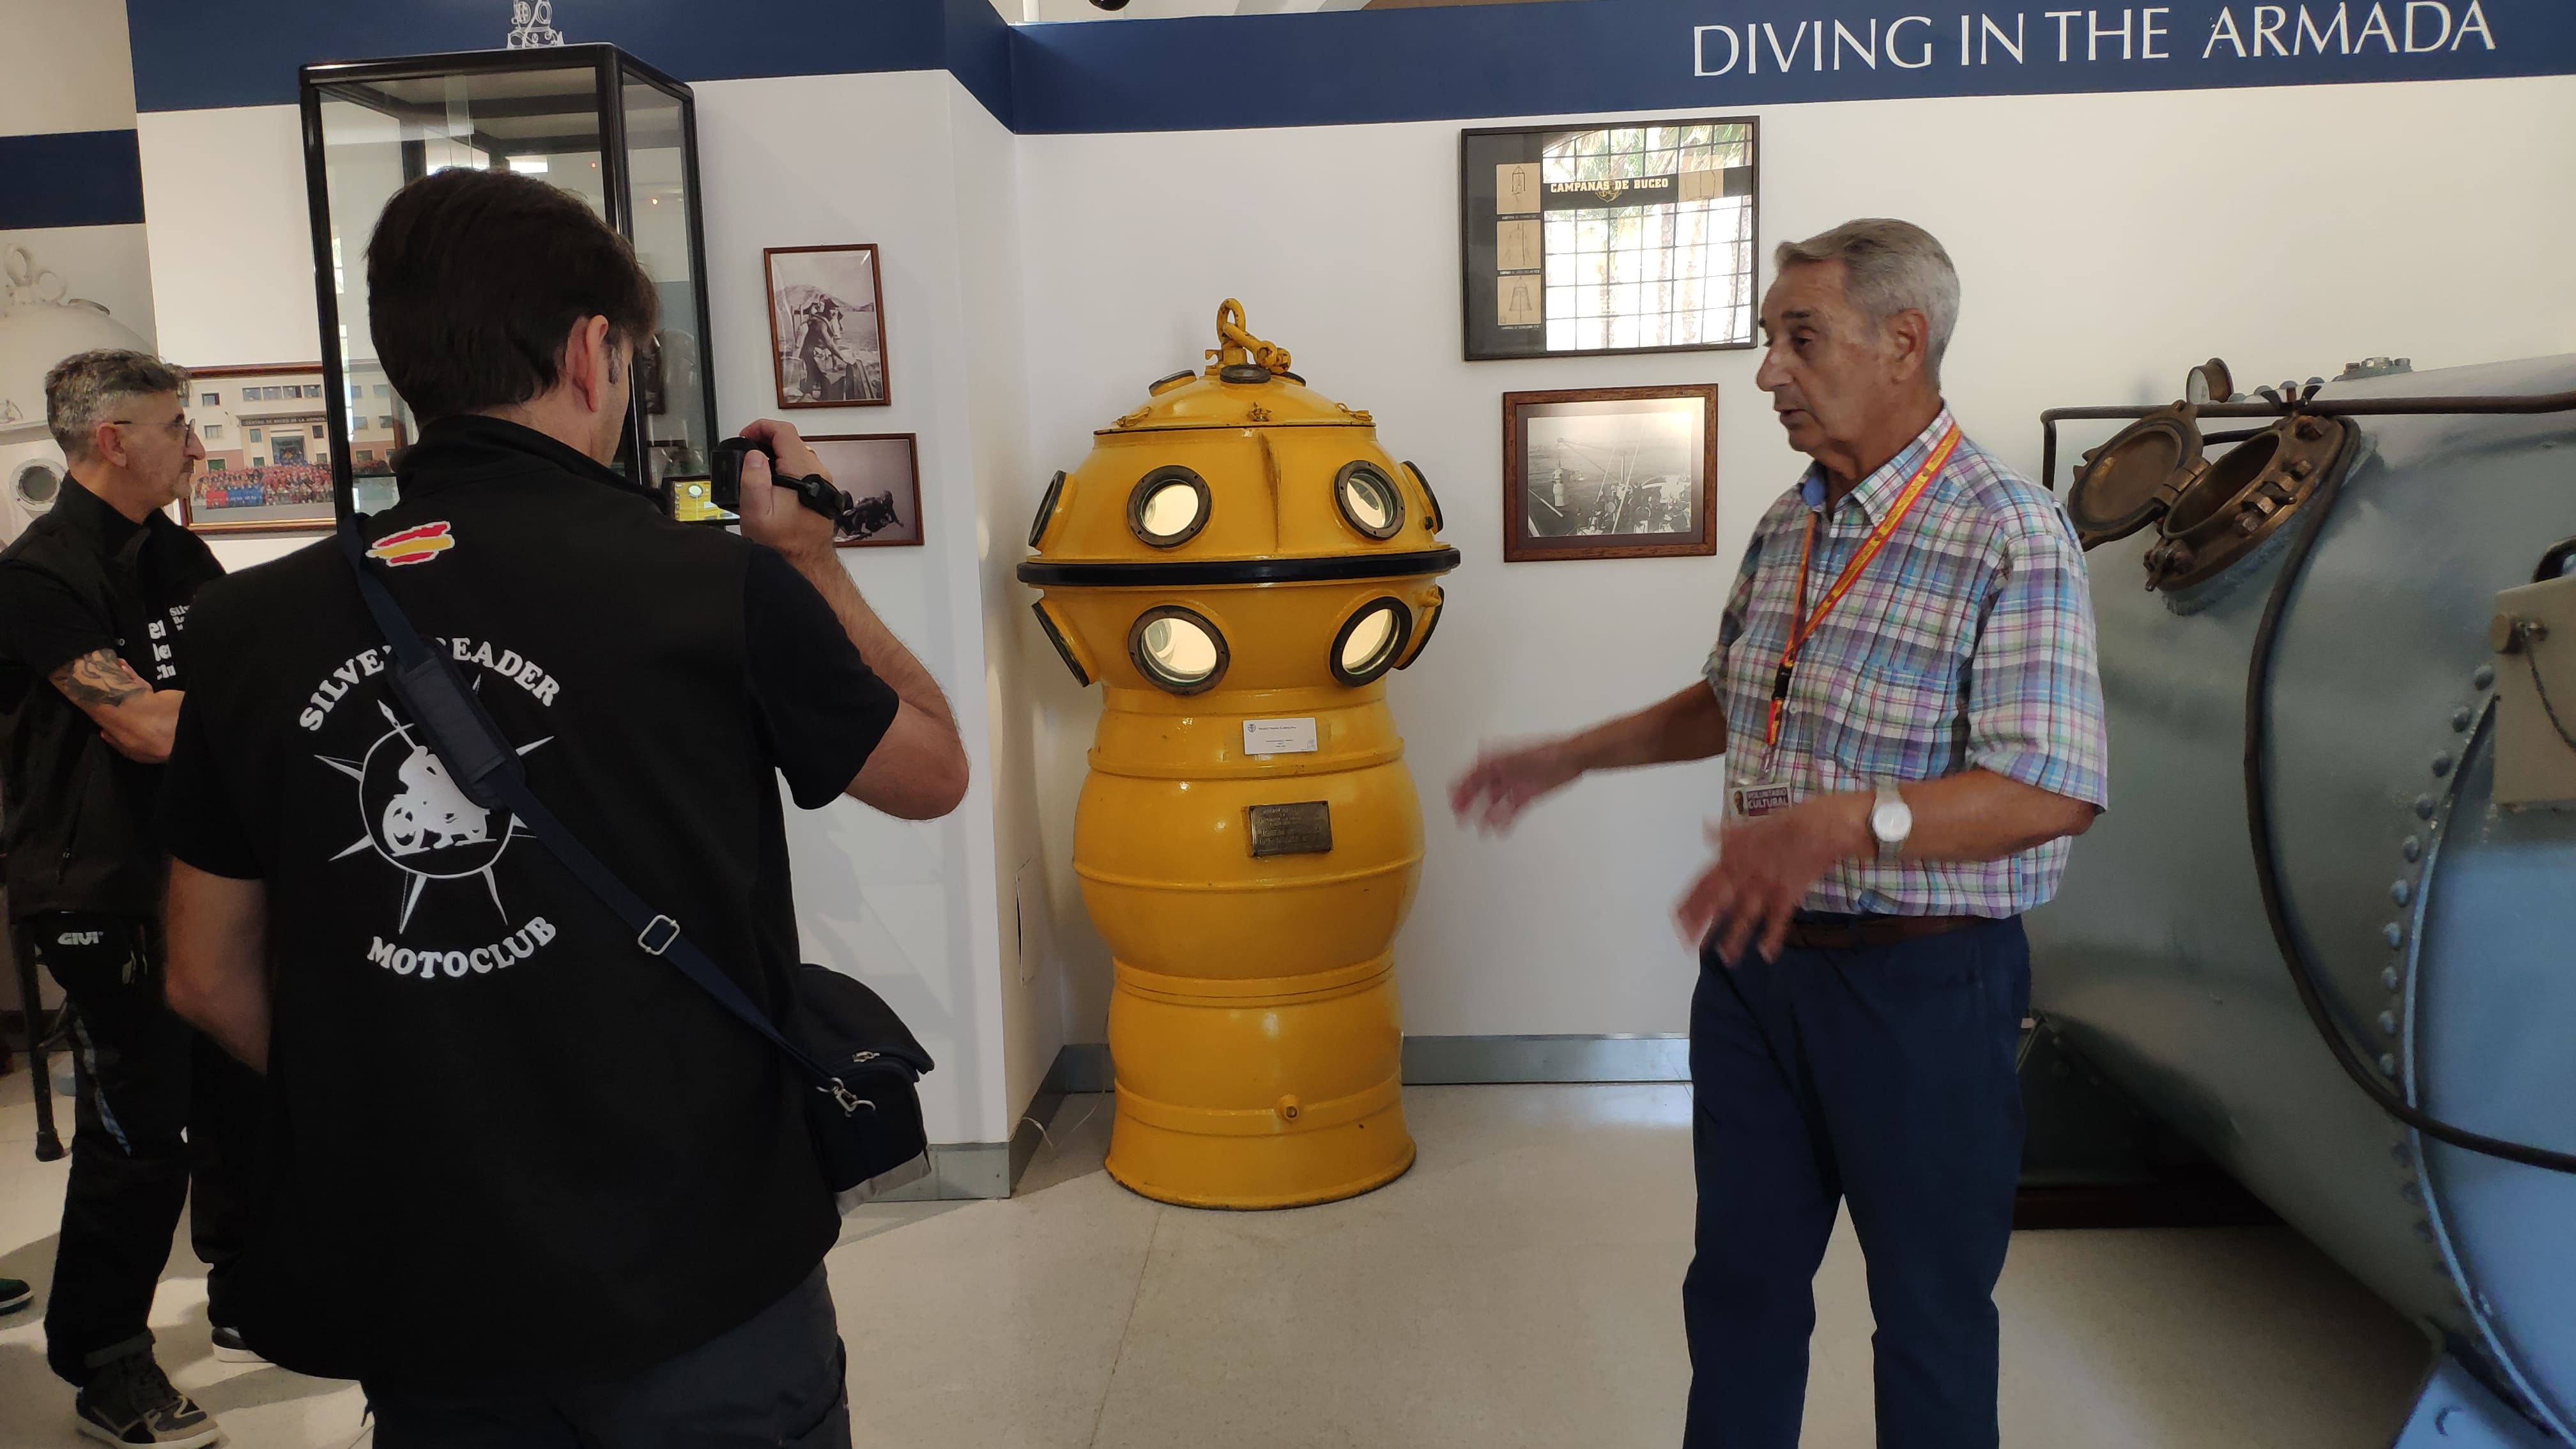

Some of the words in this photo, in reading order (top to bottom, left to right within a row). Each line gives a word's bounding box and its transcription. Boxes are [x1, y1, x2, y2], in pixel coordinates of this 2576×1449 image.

[1694, 15, 1933, 77] DIVING
[1960, 12, 2025, 66] IN
[2044, 7, 2170, 62] THE
[2202, 0, 2496, 58] ARMADA
[1550, 180, 1610, 193] CAMPANAS
[1614, 180, 1629, 190] DE
[1634, 178, 1669, 189] BUCEO
[299, 645, 392, 731] SILVE
[434, 637, 560, 707] EADER
[1748, 796, 1789, 809] CULTURAL
[57, 931, 100, 946] GIVI
[366, 916, 556, 978] MOTOCLUB
